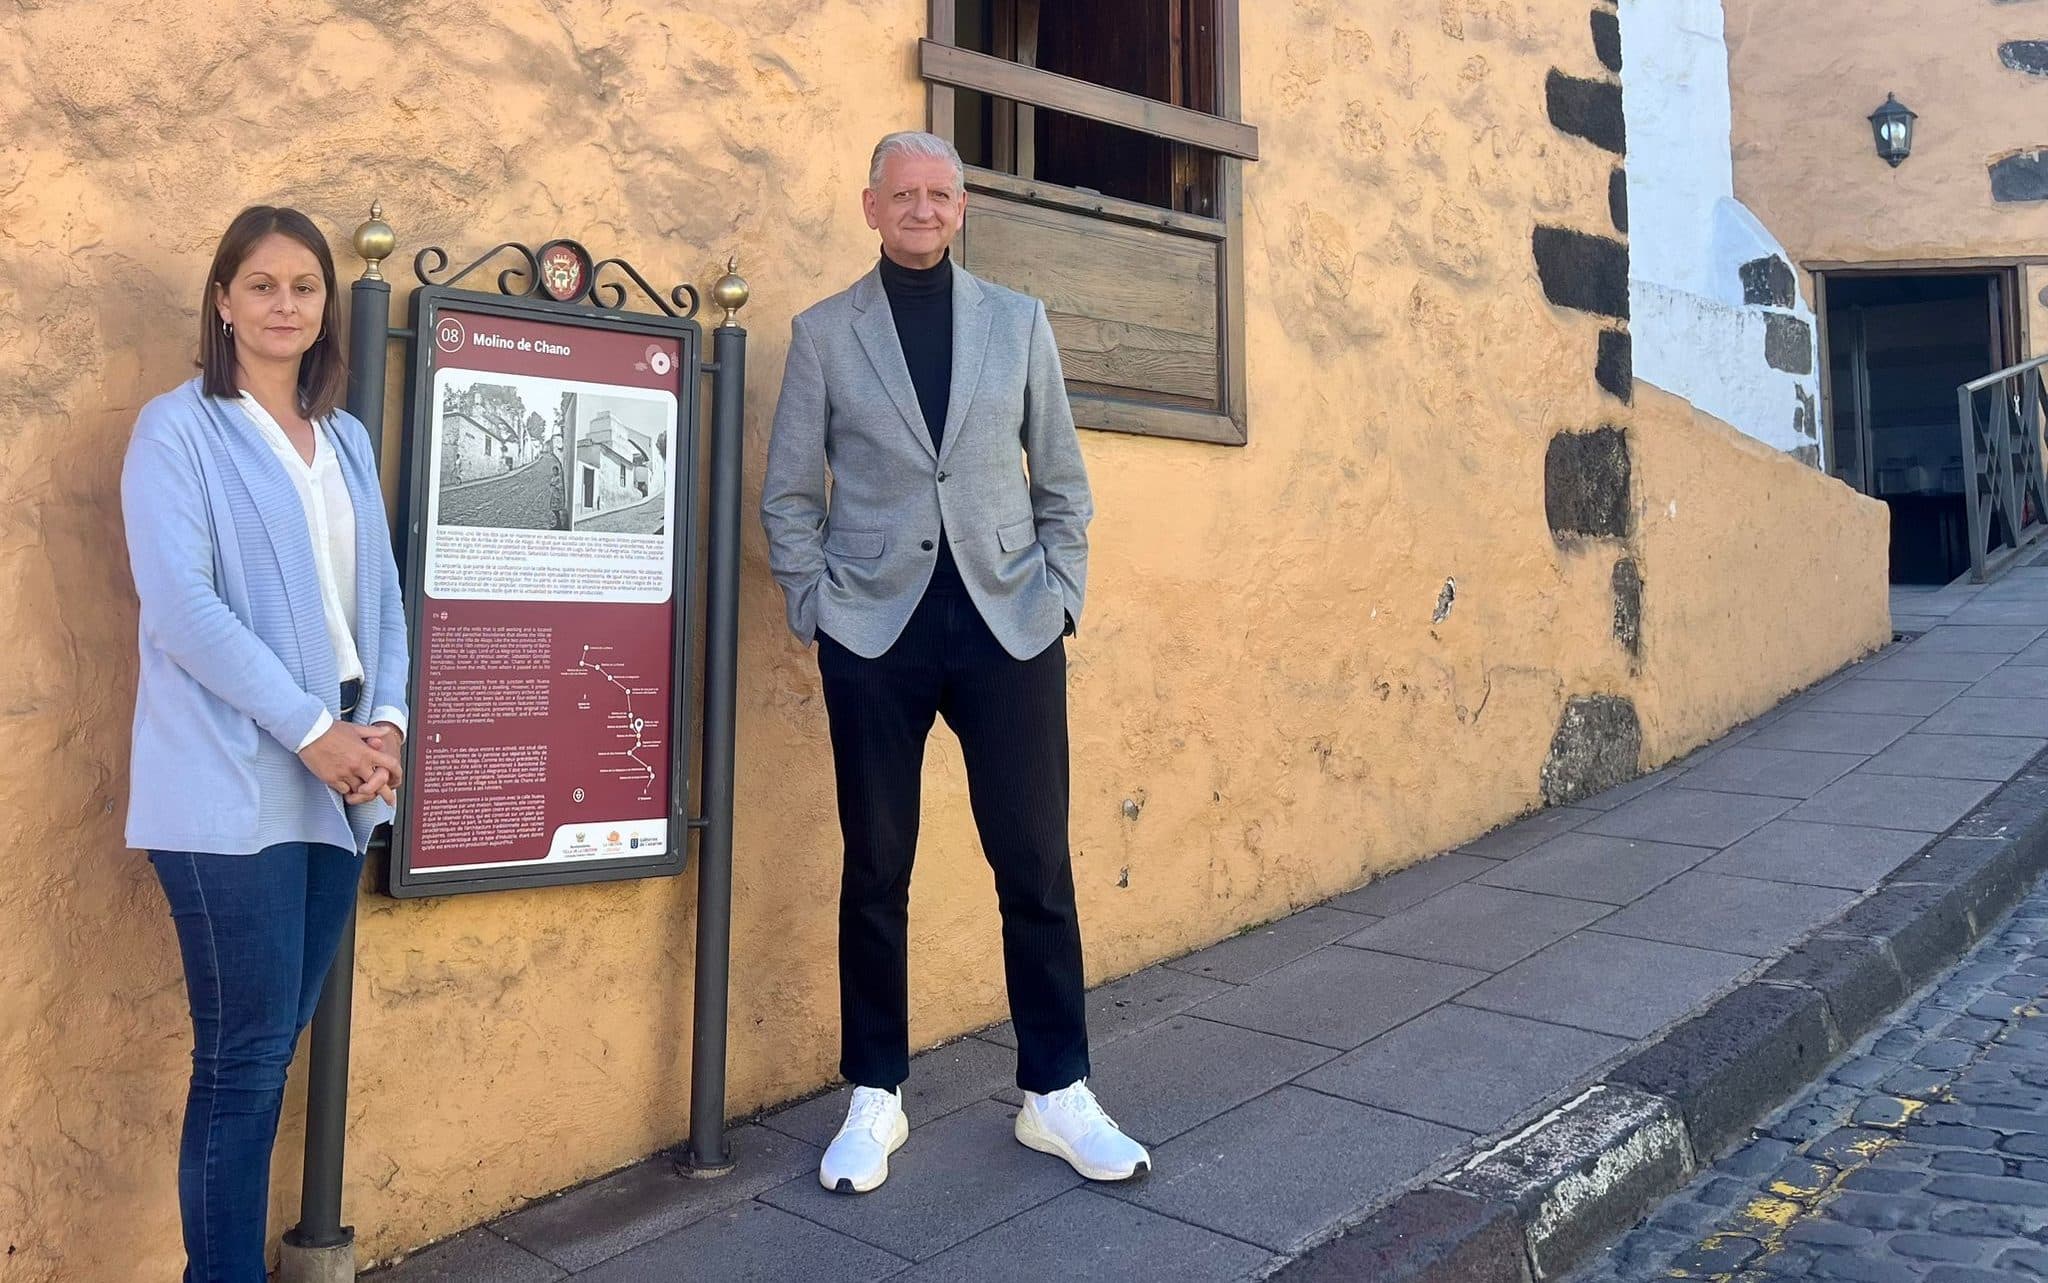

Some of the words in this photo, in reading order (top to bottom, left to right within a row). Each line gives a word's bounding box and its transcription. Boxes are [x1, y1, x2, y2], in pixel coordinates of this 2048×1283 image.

[441, 328, 459, 343] 08
[473, 333, 514, 350] Molino
[517, 338, 532, 352] de
[534, 340, 571, 356] Chano
